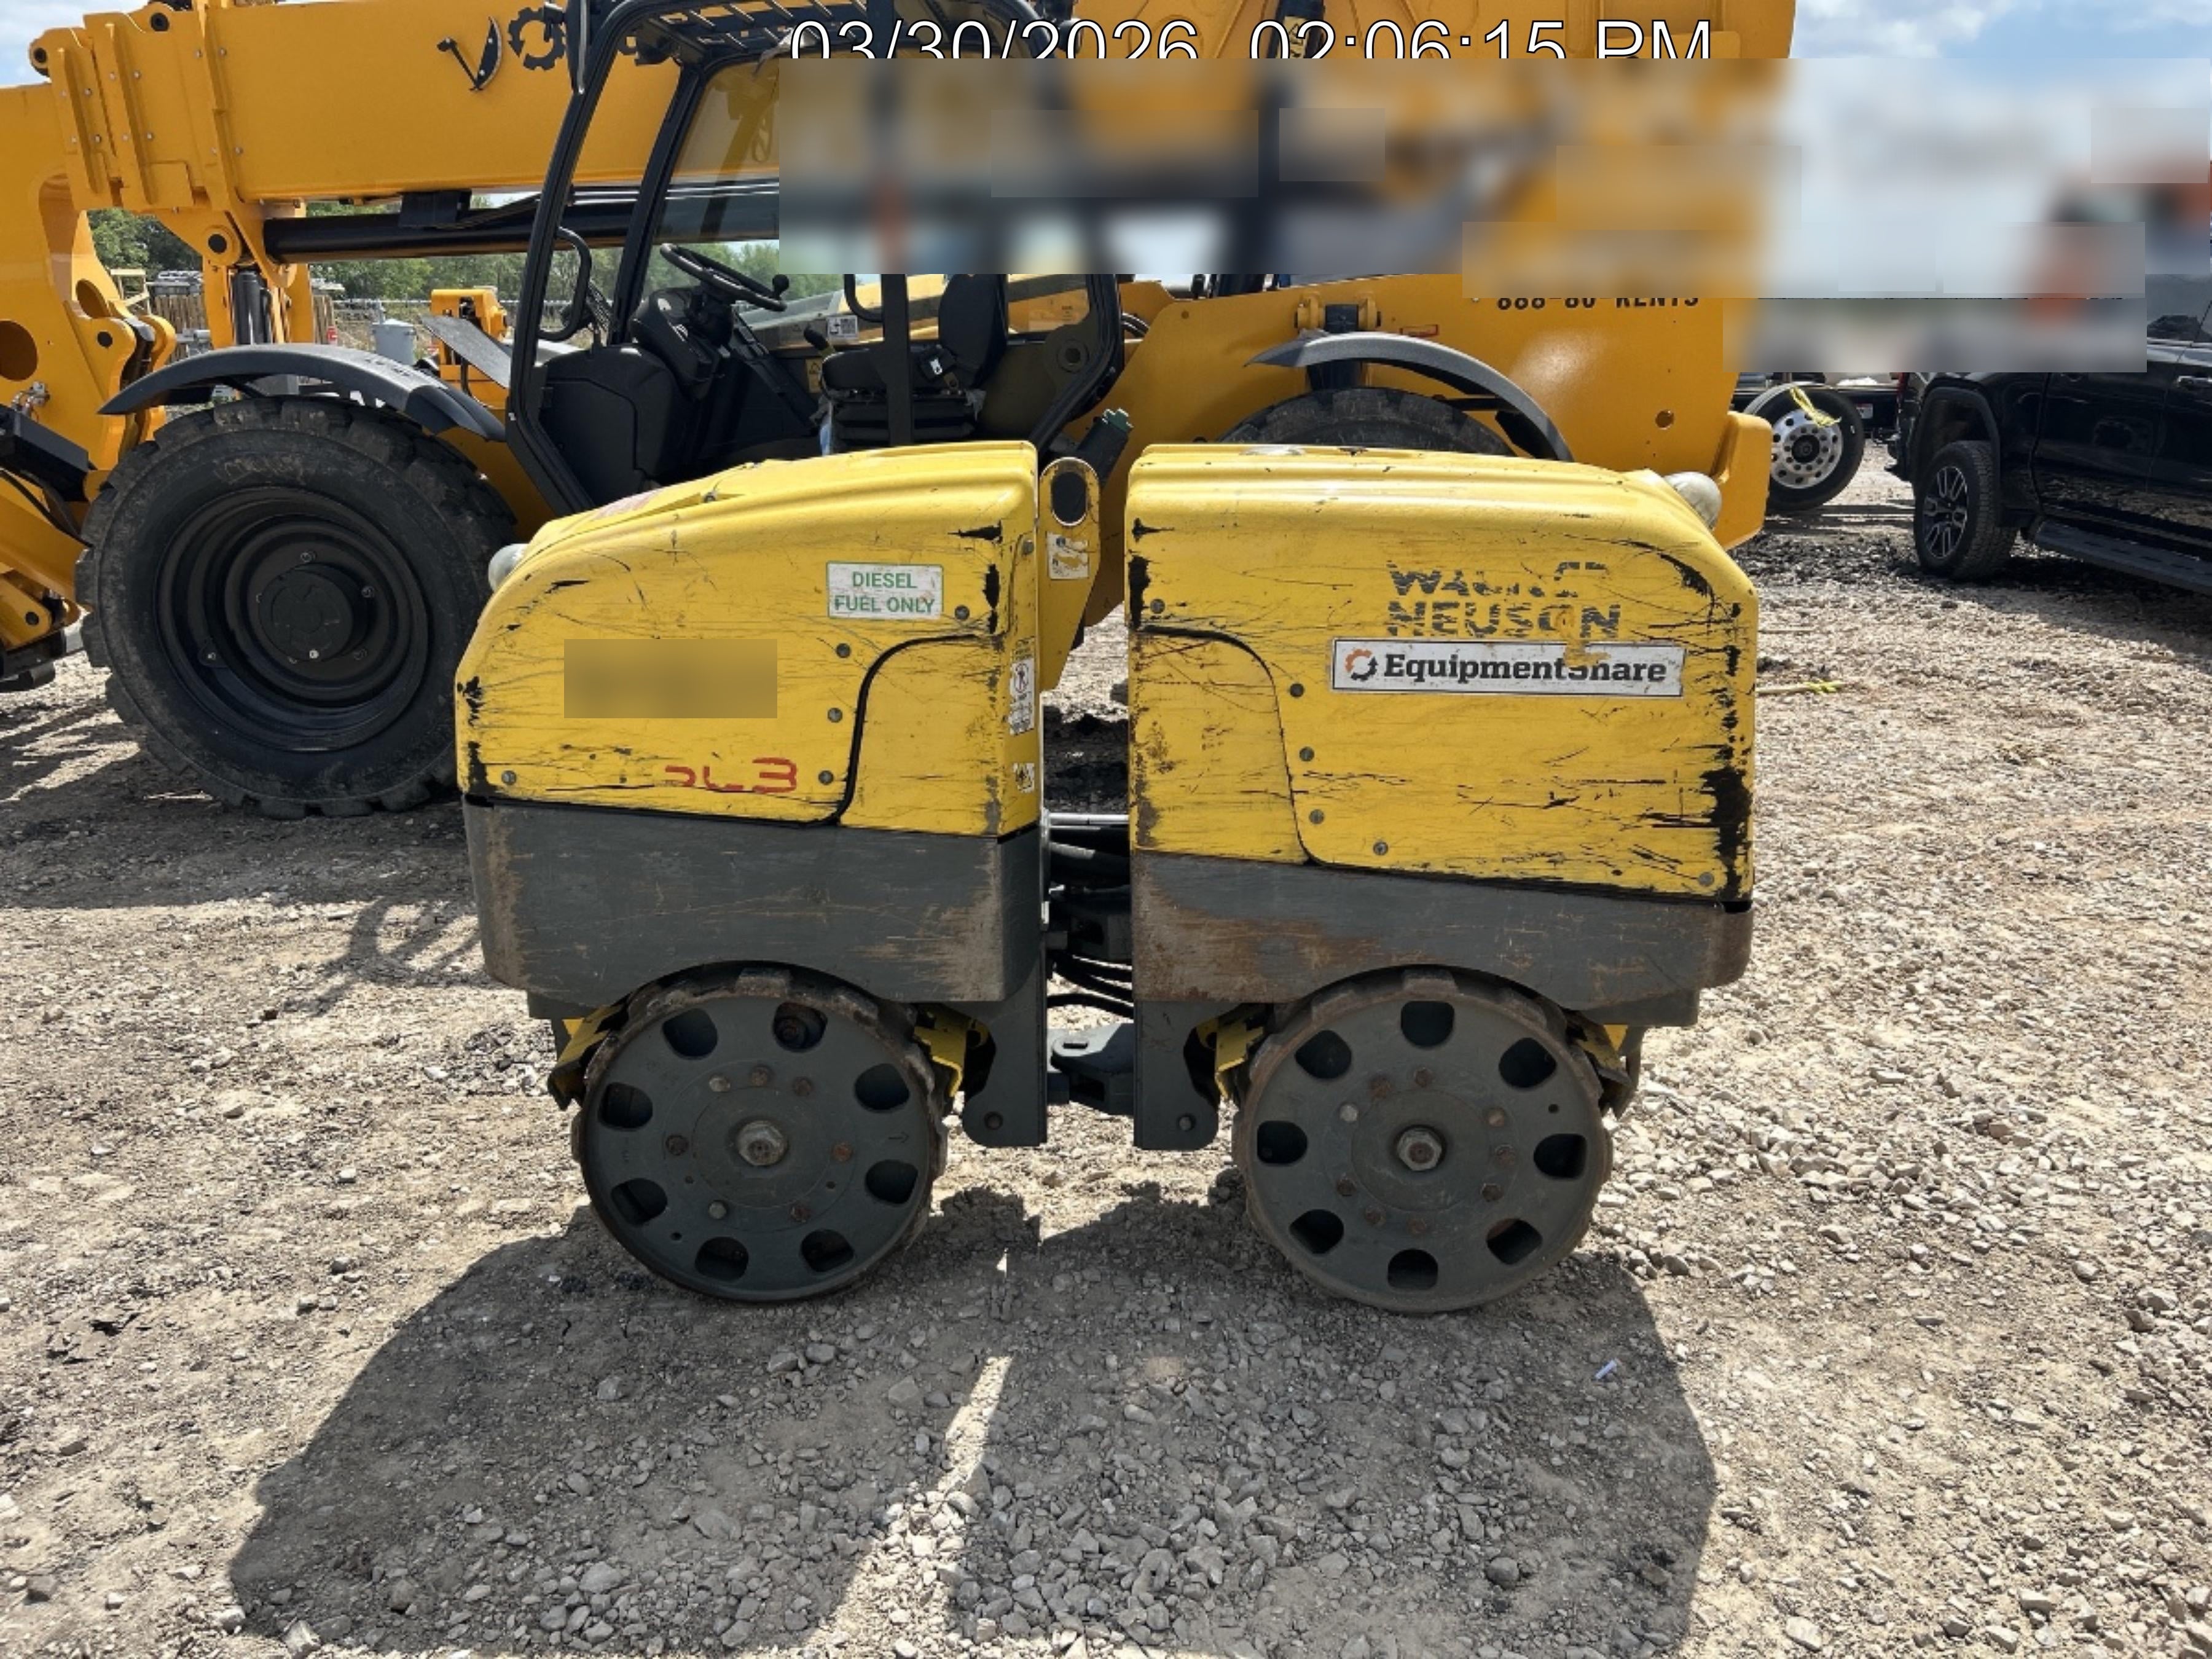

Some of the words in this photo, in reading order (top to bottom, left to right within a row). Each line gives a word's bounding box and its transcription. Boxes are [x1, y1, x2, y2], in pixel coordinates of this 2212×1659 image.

[852, 571, 918, 589] DIESEL
[834, 594, 882, 612] FUEL
[886, 596, 935, 613] ONLY
[1384, 654, 1667, 684] EquipmentShare
